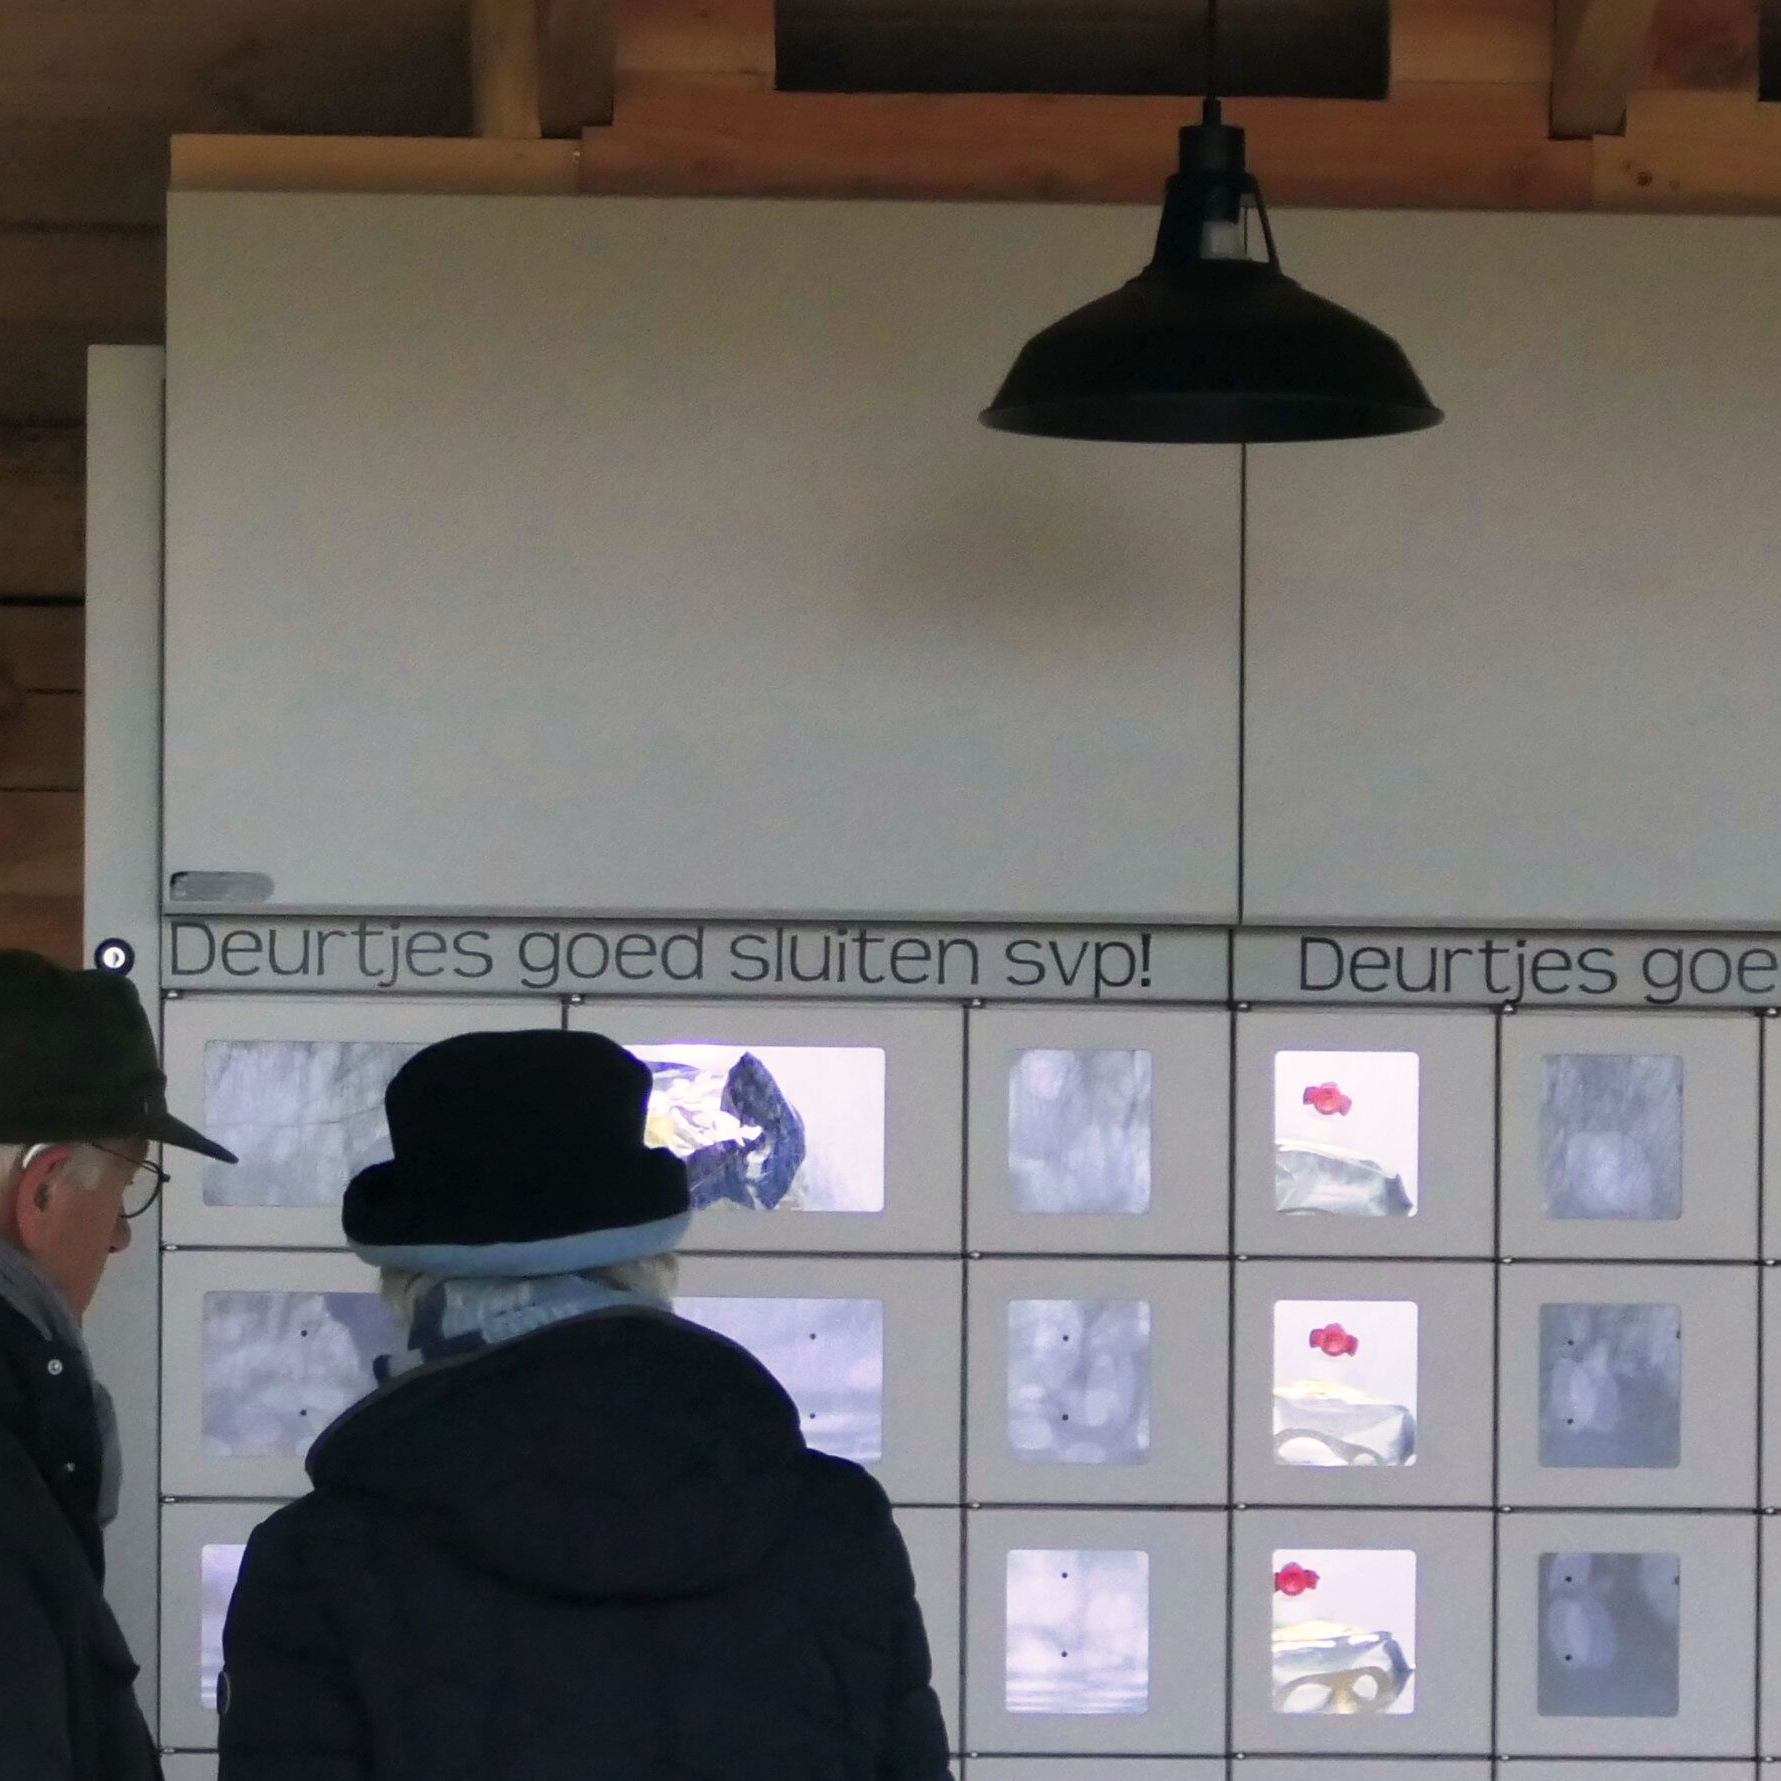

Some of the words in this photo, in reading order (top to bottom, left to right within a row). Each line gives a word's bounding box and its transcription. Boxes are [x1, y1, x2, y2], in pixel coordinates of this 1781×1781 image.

[170, 919, 494, 988] Deurtjes
[518, 925, 705, 990] goed
[729, 926, 980, 985] sluiten
[1004, 932, 1153, 999] svp!
[1299, 934, 1619, 1004] Deurtjes
